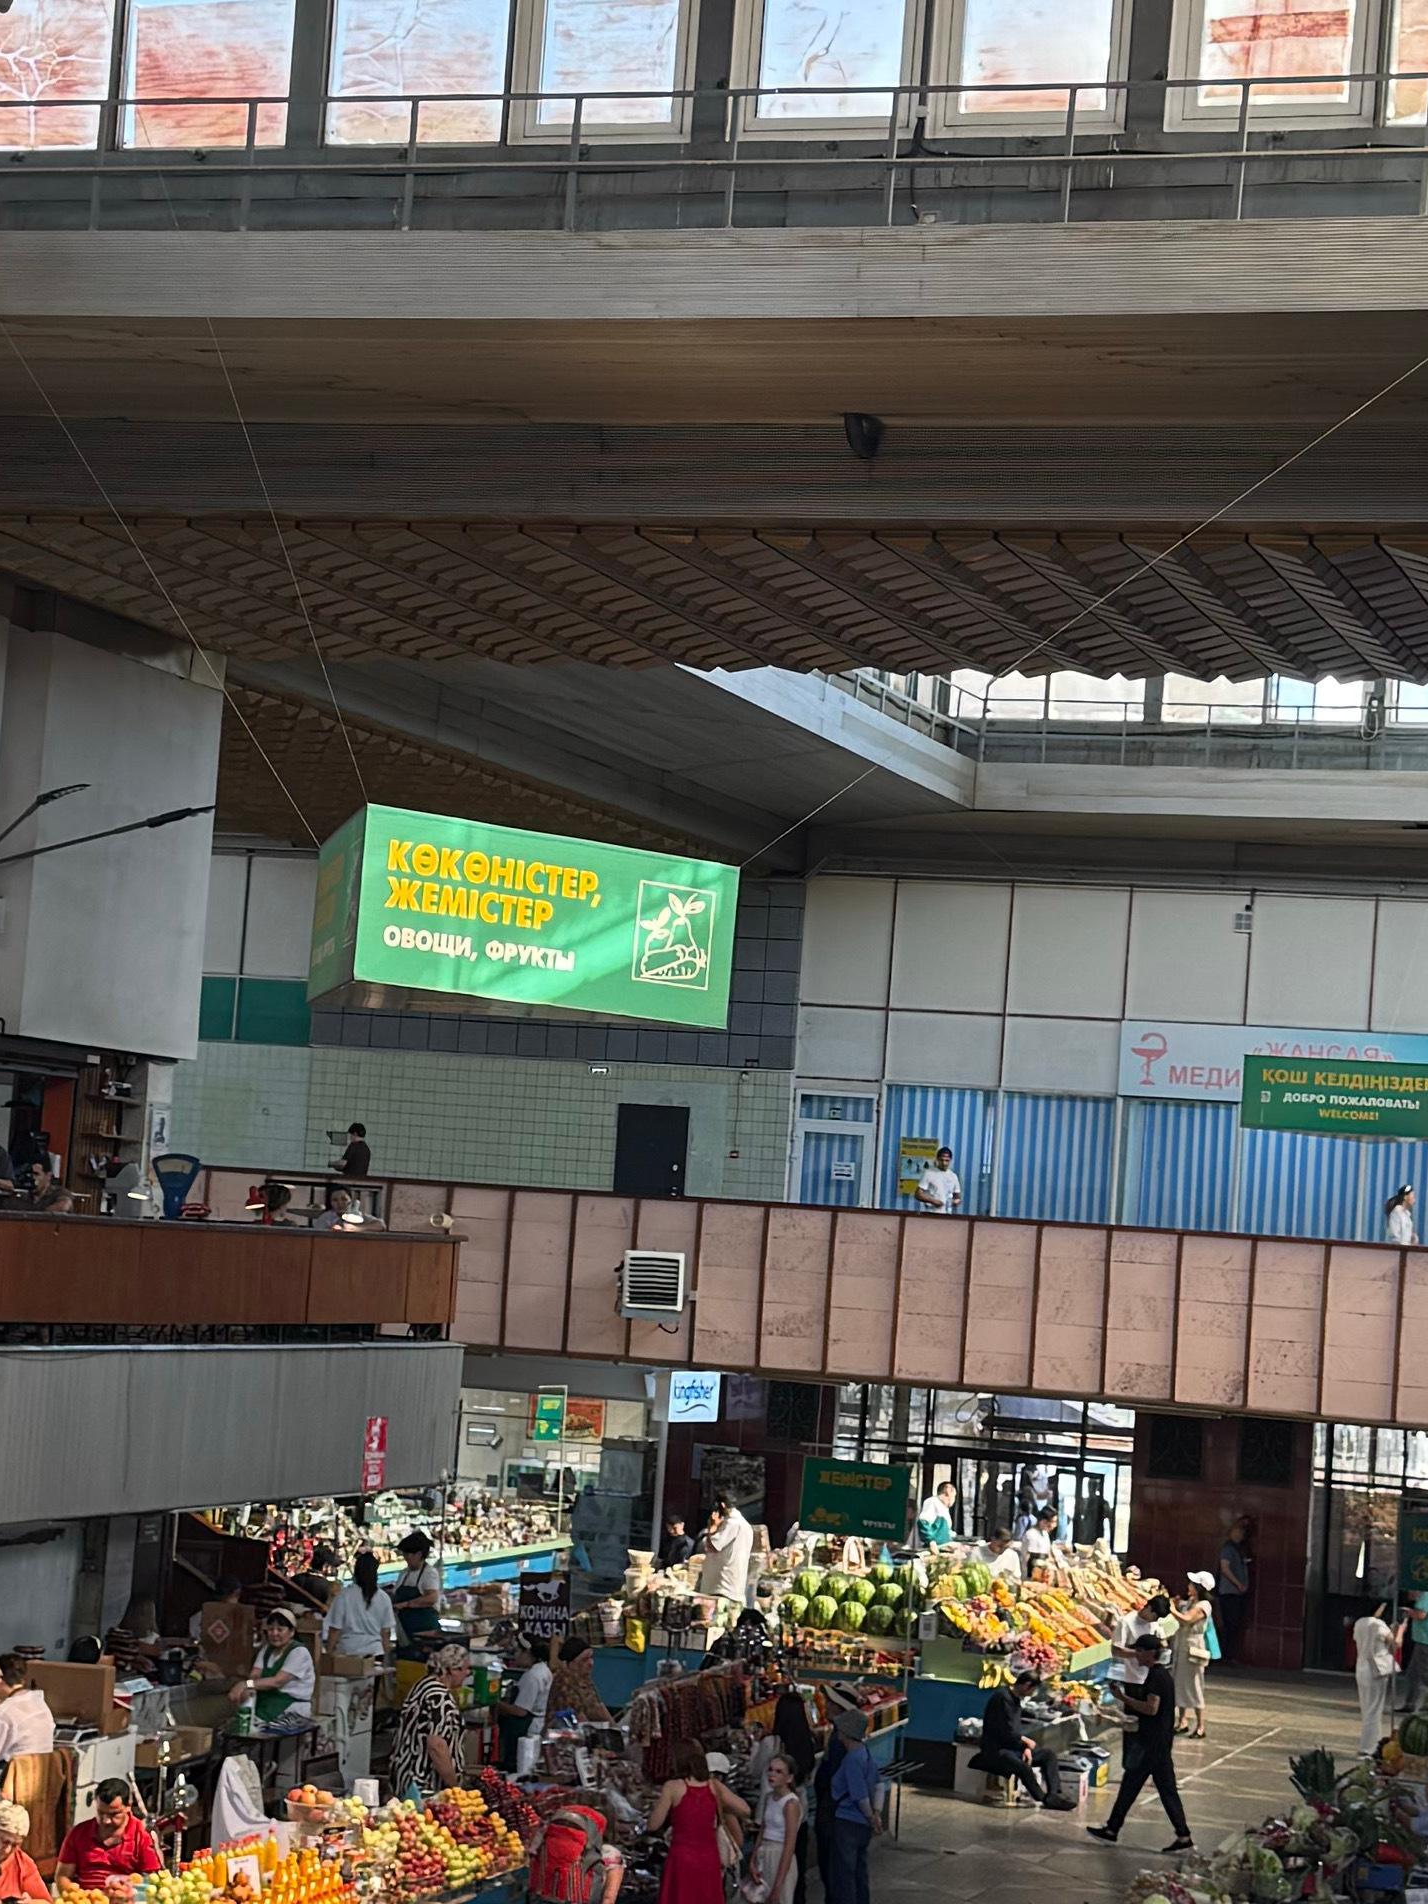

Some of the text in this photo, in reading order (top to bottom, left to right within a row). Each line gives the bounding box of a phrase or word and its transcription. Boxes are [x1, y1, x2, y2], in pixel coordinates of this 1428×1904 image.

[386, 839, 603, 908] КӨКӨНІСТЕР,
[384, 876, 554, 930] ЖЕМІСТЕР
[382, 925, 576, 972] ОВОЩИ, ФРУКТЫ
[1261, 1068, 1308, 1086] ҚОШ
[1282, 1092, 1420, 1111] ДОБРО ПОЖАЛОВАТЬ!
[1318, 1108, 1379, 1121] WELCOME!
[520, 1604, 569, 1620] КОНИНА
